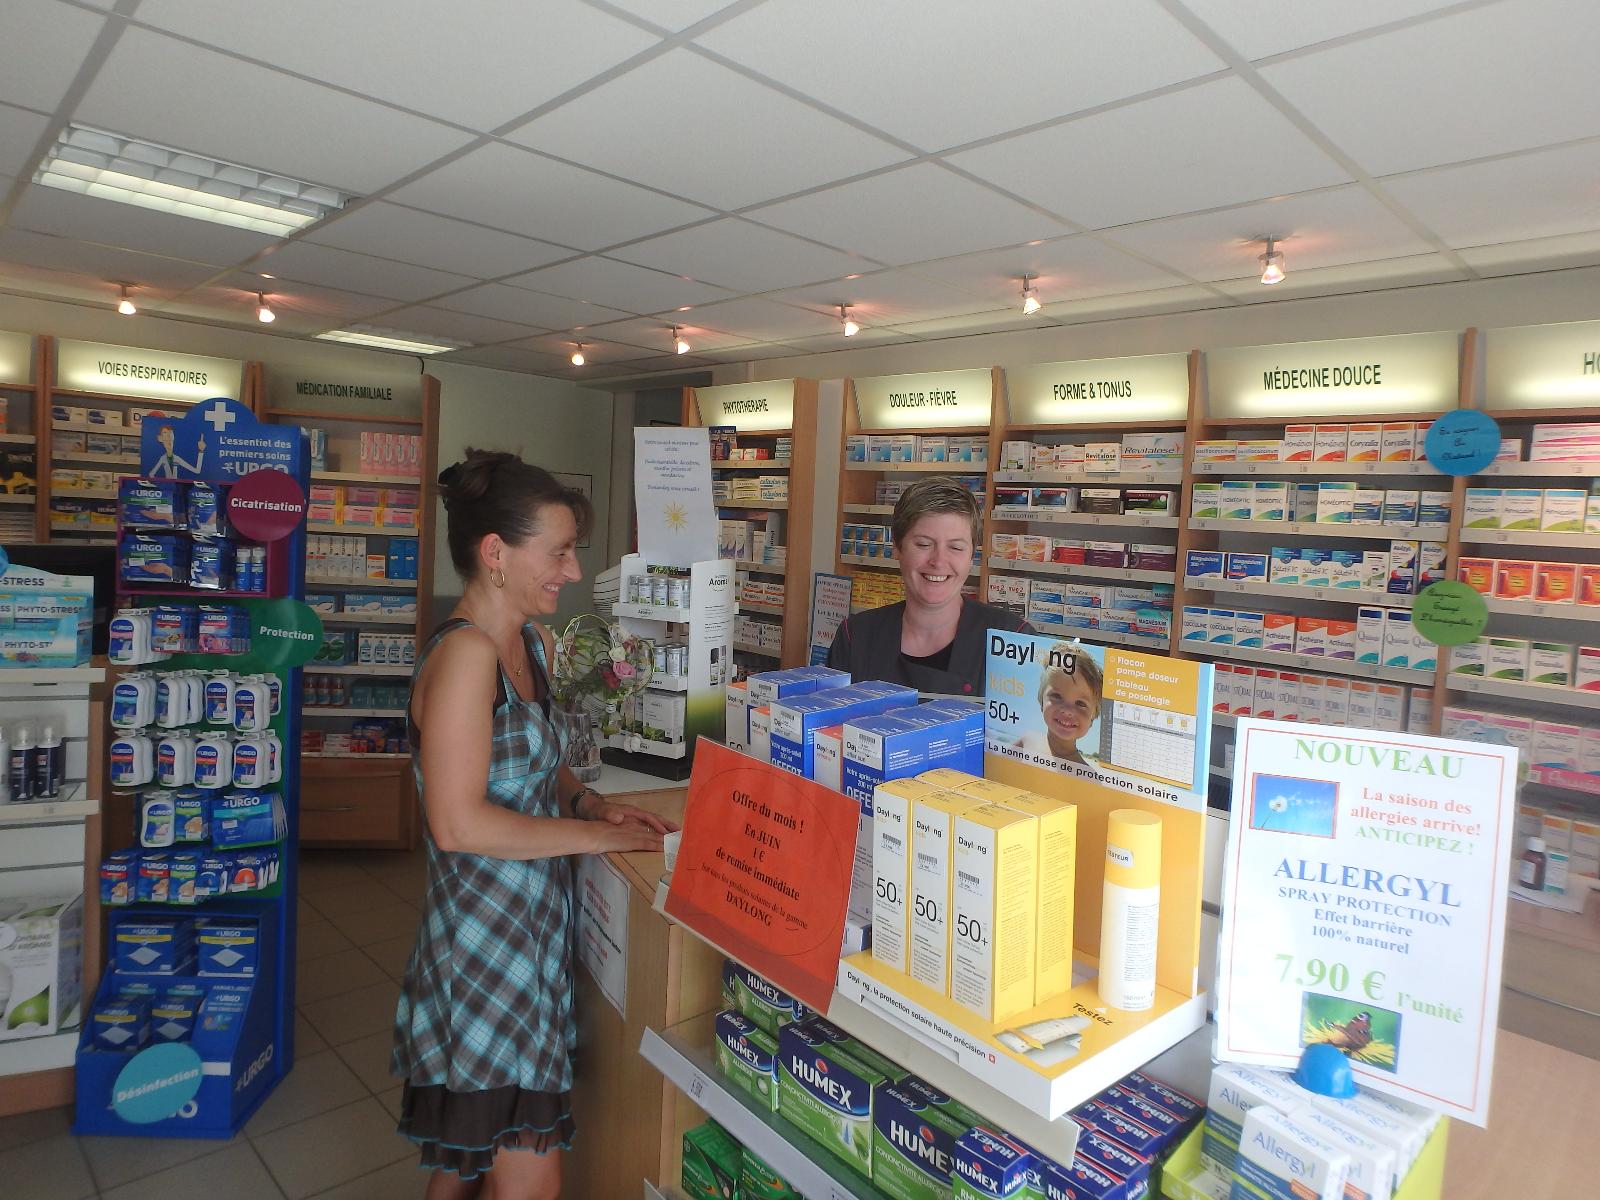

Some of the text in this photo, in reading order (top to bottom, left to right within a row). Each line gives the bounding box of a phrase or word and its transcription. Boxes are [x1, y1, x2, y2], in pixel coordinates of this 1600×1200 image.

[98, 361, 208, 386] VOIES RESPIRATOIRES
[1264, 364, 1382, 390] MÉDECINE DOUCE
[296, 380, 392, 401] MÉDICATION FAMILIALE
[890, 388, 958, 408] DOULEUR FIÈVRE
[1054, 380, 1132, 401] FORME & TONUS
[723, 399, 769, 415] PHYTOTHERAPIE
[220, 436, 292, 449] L'essentiel des
[219, 450, 292, 461] premiers soins
[1086, 452, 1117, 460] Revitalose
[136, 490, 162, 498] URGO
[231, 498, 302, 513] Cicatrisation
[136, 545, 163, 553] URGO
[18, 606, 82, 614] PHYTO-STRES
[260, 626, 314, 641] Protection
[1117, 656, 1145, 668] Flacon
[1116, 667, 1179, 684] pompe doseur
[1116, 679, 1149, 692] Tableau
[1116, 688, 1171, 706] de posologie
[989, 700, 1020, 724] 50+
[1296, 738, 1465, 779] NOUVEAU
[988, 742, 1179, 802] La bonne dose de protection solaire
[230, 798, 260, 809] URGO
[846, 786, 874, 810] OFFE
[1363, 787, 1472, 815] La saison des
[732, 790, 804, 834] Offre du mois !
[876, 806, 901, 823] Daylng
[1351, 806, 1481, 836] allergies arrive!
[744, 824, 781, 851] En JUIN
[916, 820, 942, 838] Daylng
[1355, 826, 1463, 854] ANTICIPEZ
[760, 850, 767, 863] €
[958, 836, 987, 855] Daylng
[108, 864, 127, 872] URGO
[146, 862, 168, 870] URGO
[716, 846, 800, 901] de remise immédiate
[876, 876, 903, 906] 50+
[1274, 858, 1462, 908] ALLERGYL
[726, 890, 772, 927] DAYLONG
[915, 894, 944, 925] 50+
[1278, 886, 1453, 927] SPRAY PROTECTION
[957, 914, 988, 947] 50+
[1314, 908, 1413, 938] Effet barrière
[1312, 925, 1409, 955] 100% naturel
[748, 974, 780, 1004] HUMEX
[1275, 954, 1465, 1024] 7.90 € l'unité
[723, 1014, 748, 1031] HUMEX
[874, 986, 879, 996] la
[880, 992, 910, 1015] protection
[912, 1010, 933, 1028] solaire
[934, 1022, 953, 1039] haute
[954, 1034, 986, 1059] précision
[1072, 1003, 1113, 1026] Testez
[789, 1027, 816, 1045] HUMEX
[728, 1034, 759, 1067] HUMEX
[243, 1044, 274, 1087] URGO
[117, 1068, 199, 1103] Désinfection
[792, 1055, 852, 1113] HUMEX
[910, 1082, 940, 1101] HUMEX
[1151, 1083, 1196, 1110] HUMEX
[886, 1088, 918, 1108] HUMEX
[1220, 1088, 1251, 1112] Aller
[1128, 1098, 1175, 1125] HUMEX
[1102, 1111, 1149, 1141] HUMEX
[970, 1130, 1016, 1159] HUMEX
[1088, 1134, 1138, 1167] HUMEX
[1252, 1131, 1316, 1179] Allergyl
[956, 1158, 998, 1194] HUMEX
[1072, 1162, 1112, 1188] HUME
